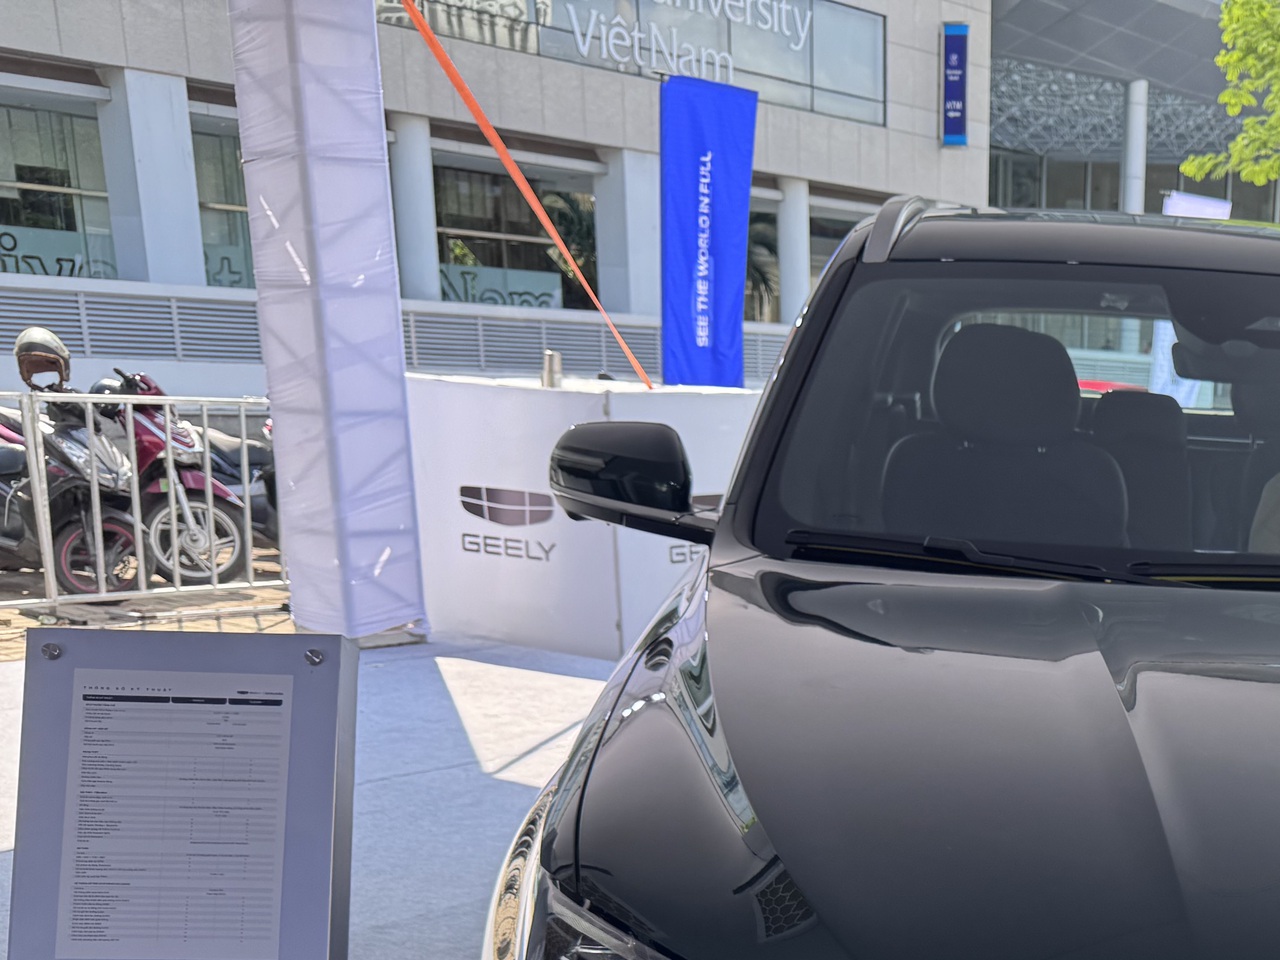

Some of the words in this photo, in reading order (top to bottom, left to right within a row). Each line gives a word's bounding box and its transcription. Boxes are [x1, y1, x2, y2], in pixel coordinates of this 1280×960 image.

[652, 0, 812, 51] versity
[699, 151, 712, 195] FULL
[699, 198, 711, 213] IN
[697, 217, 711, 277] WORLD
[696, 279, 709, 310] THE
[696, 320, 709, 347] SEE
[461, 532, 556, 562] GEELY
